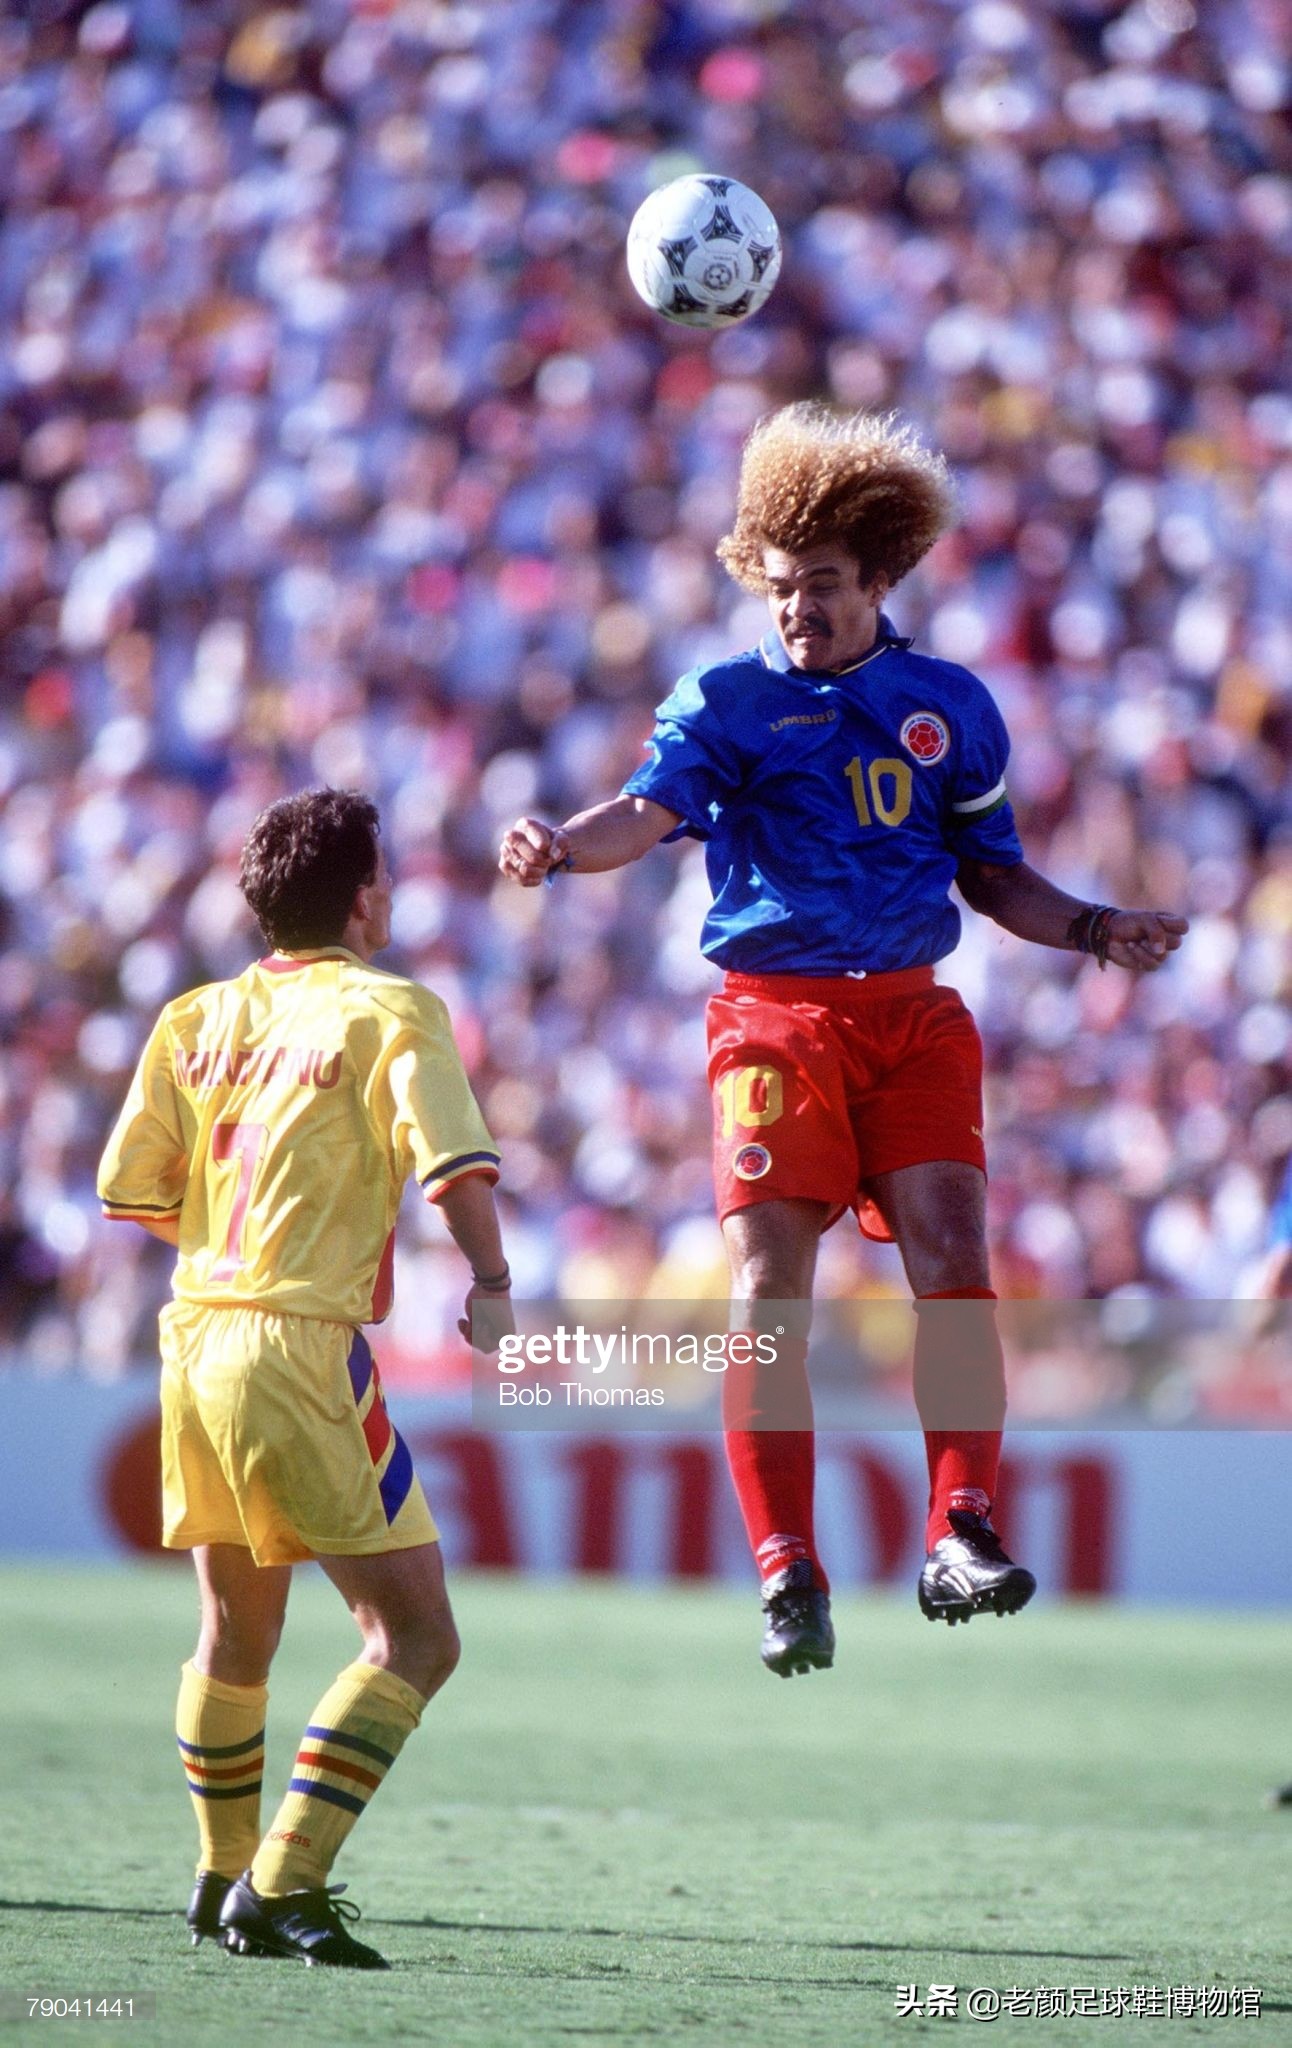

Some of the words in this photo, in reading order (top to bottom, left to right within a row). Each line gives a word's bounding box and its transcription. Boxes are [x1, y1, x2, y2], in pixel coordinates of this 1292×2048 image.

[769, 709, 837, 732] UMBRO
[844, 756, 913, 827] 10
[718, 1065, 783, 1137] 10
